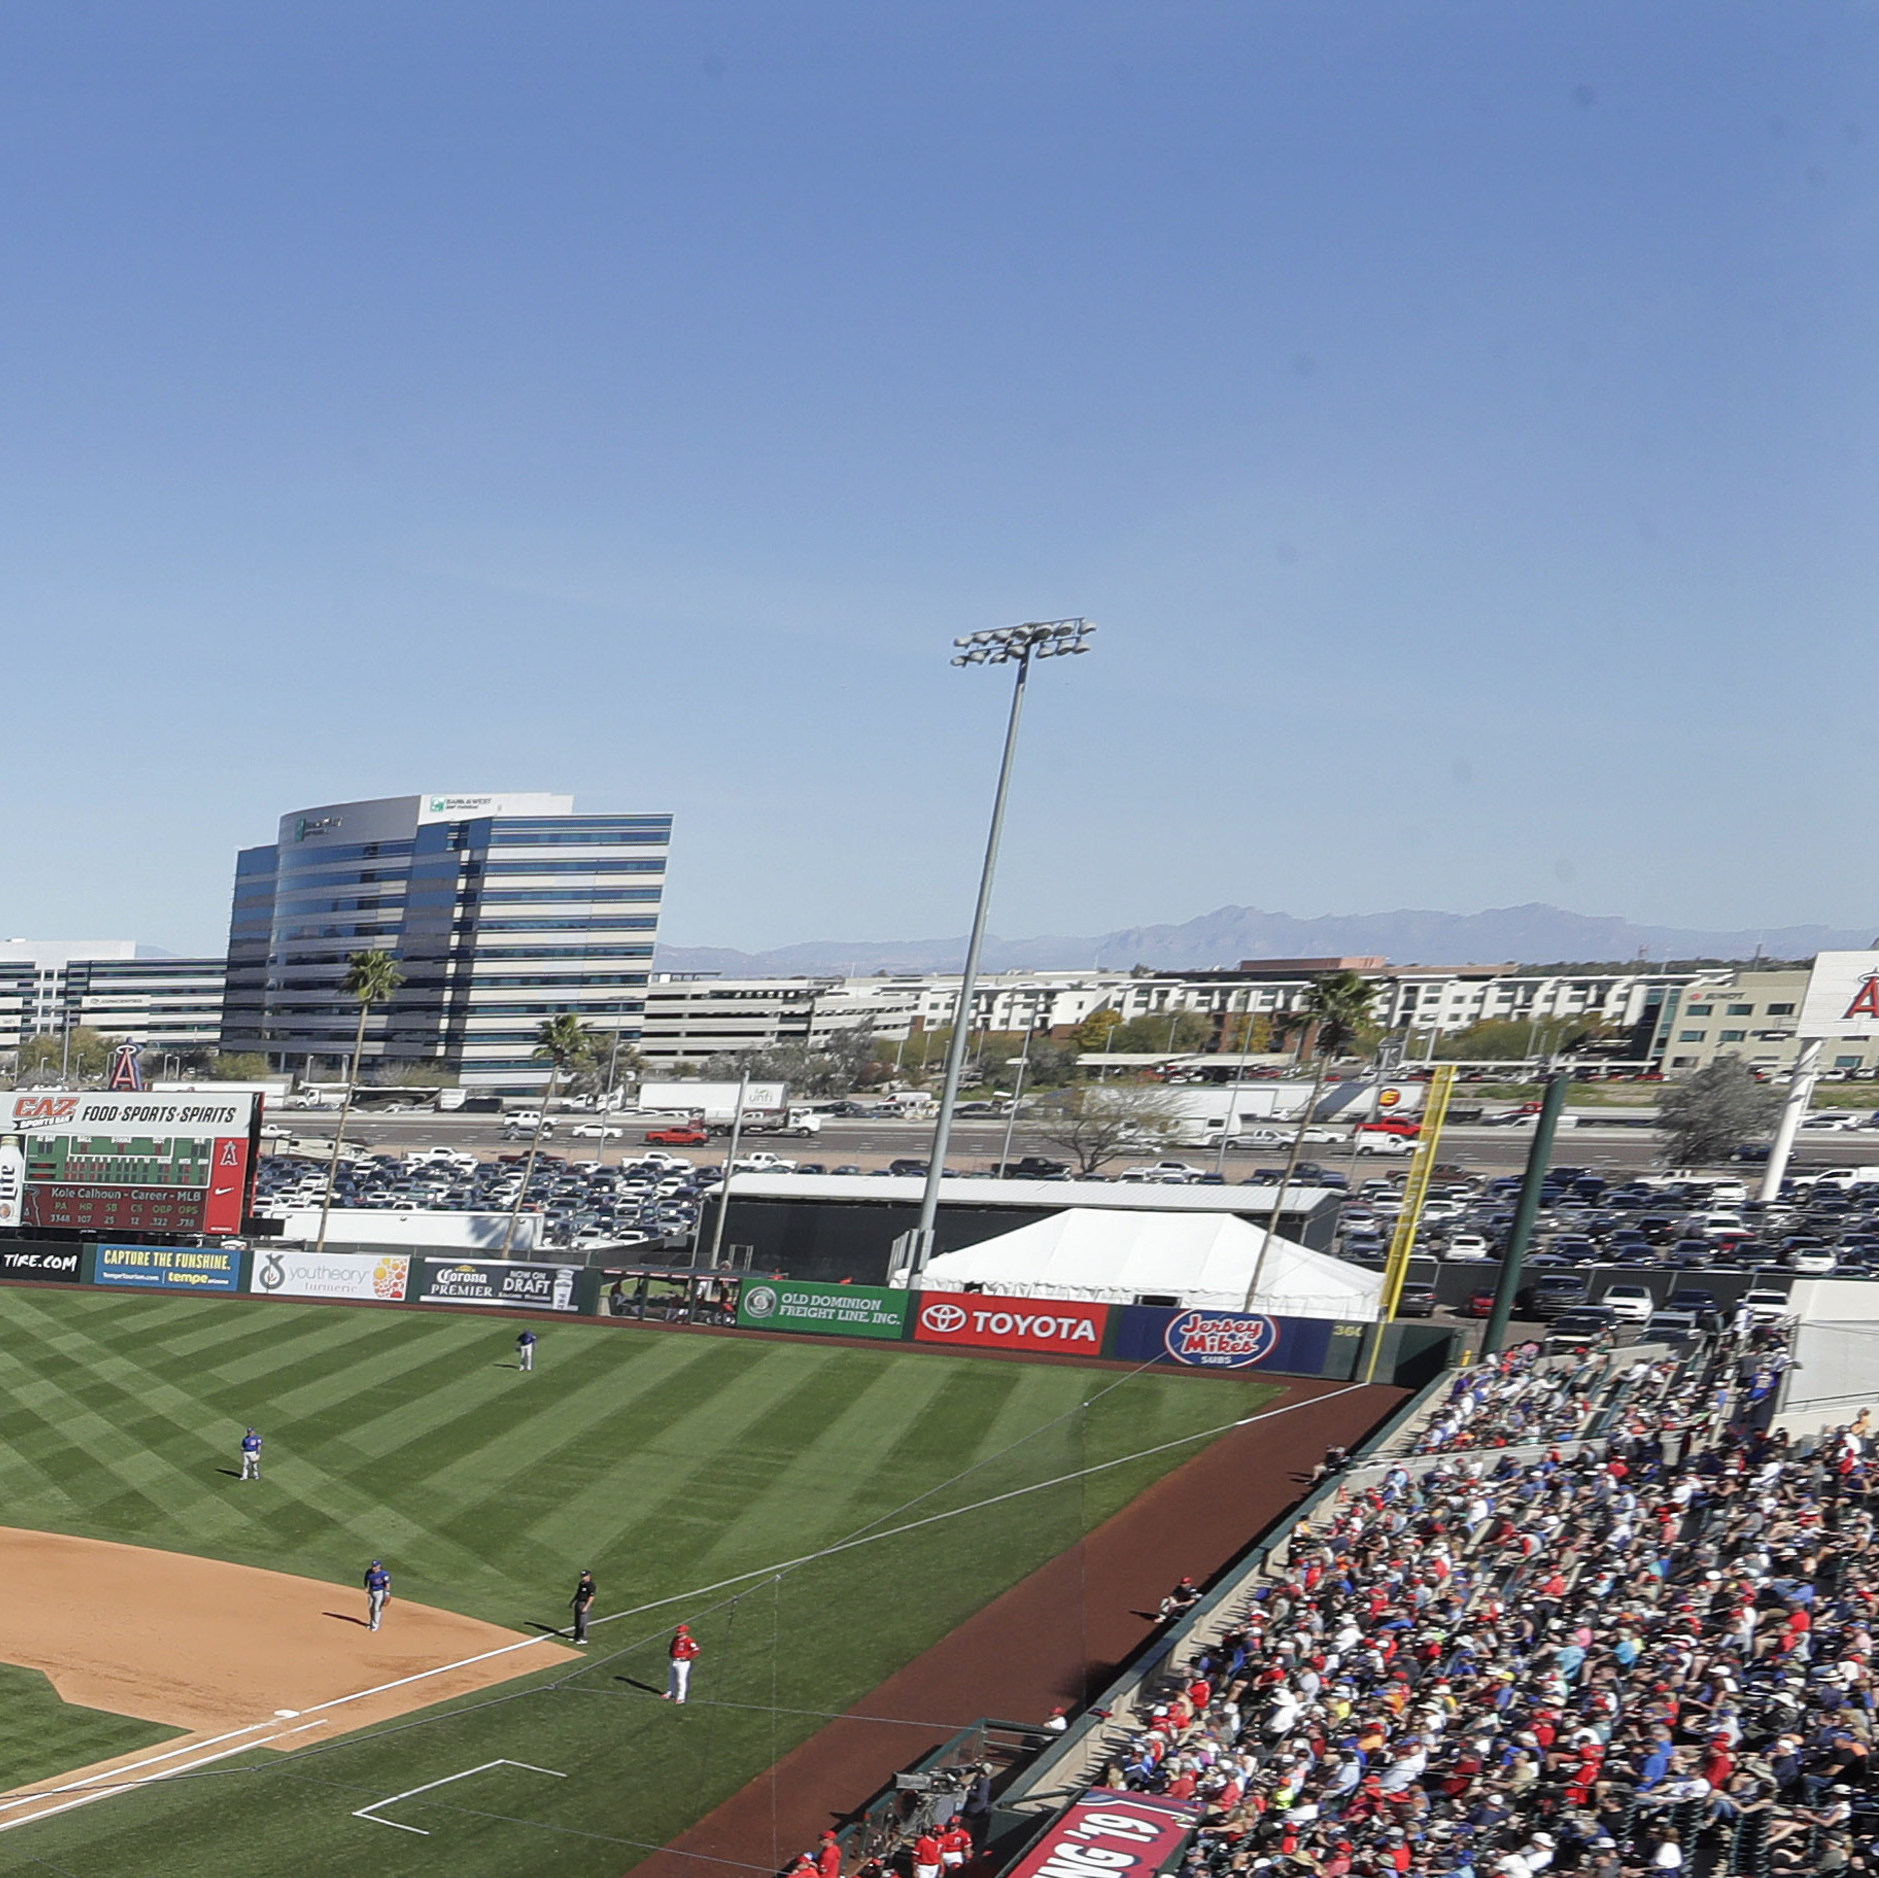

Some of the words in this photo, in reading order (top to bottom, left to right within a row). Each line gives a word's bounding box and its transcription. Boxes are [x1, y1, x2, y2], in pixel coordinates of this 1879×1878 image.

[13, 1096, 80, 1119] CAZ
[81, 1106, 119, 1122] FOOD
[122, 1106, 176, 1122] SPORTS
[181, 1106, 236, 1123] SPIRITS
[51, 1187, 75, 1199] Kole
[77, 1187, 122, 1200] Calhoun
[131, 1189, 167, 1201] Career
[177, 1191, 202, 1202] MLB
[54, 1202, 67, 1211] PA
[79, 1202, 93, 1212] HR
[105, 1203, 118, 1212] SB
[130, 1203, 144, 1213] CS
[152, 1204, 172, 1214] OBP
[178, 1204, 199, 1215] OPS
[77, 1213, 92, 1224] 107
[3, 1253, 79, 1272] TIRE.COM
[103, 1249, 151, 1265] CAPTURE
[153, 1251, 173, 1267] THE
[168, 1271, 209, 1285] tempe
[289, 1265, 368, 1284] youtheory
[436, 1268, 488, 1285] Corona
[431, 1283, 493, 1298] PREMIER
[503, 1278, 552, 1295] DRAFT
[781, 1292, 808, 1305] OLD
[811, 1294, 882, 1311] DOMINION
[778, 1304, 836, 1321] FREIGHT
[871, 1311, 902, 1325] INC.
[972, 1310, 1097, 1342] TOYOTA
[1181, 1313, 1264, 1340] Jersey
[1200, 1354, 1233, 1366] SUBS
[1063, 1812, 1162, 1843] '19
